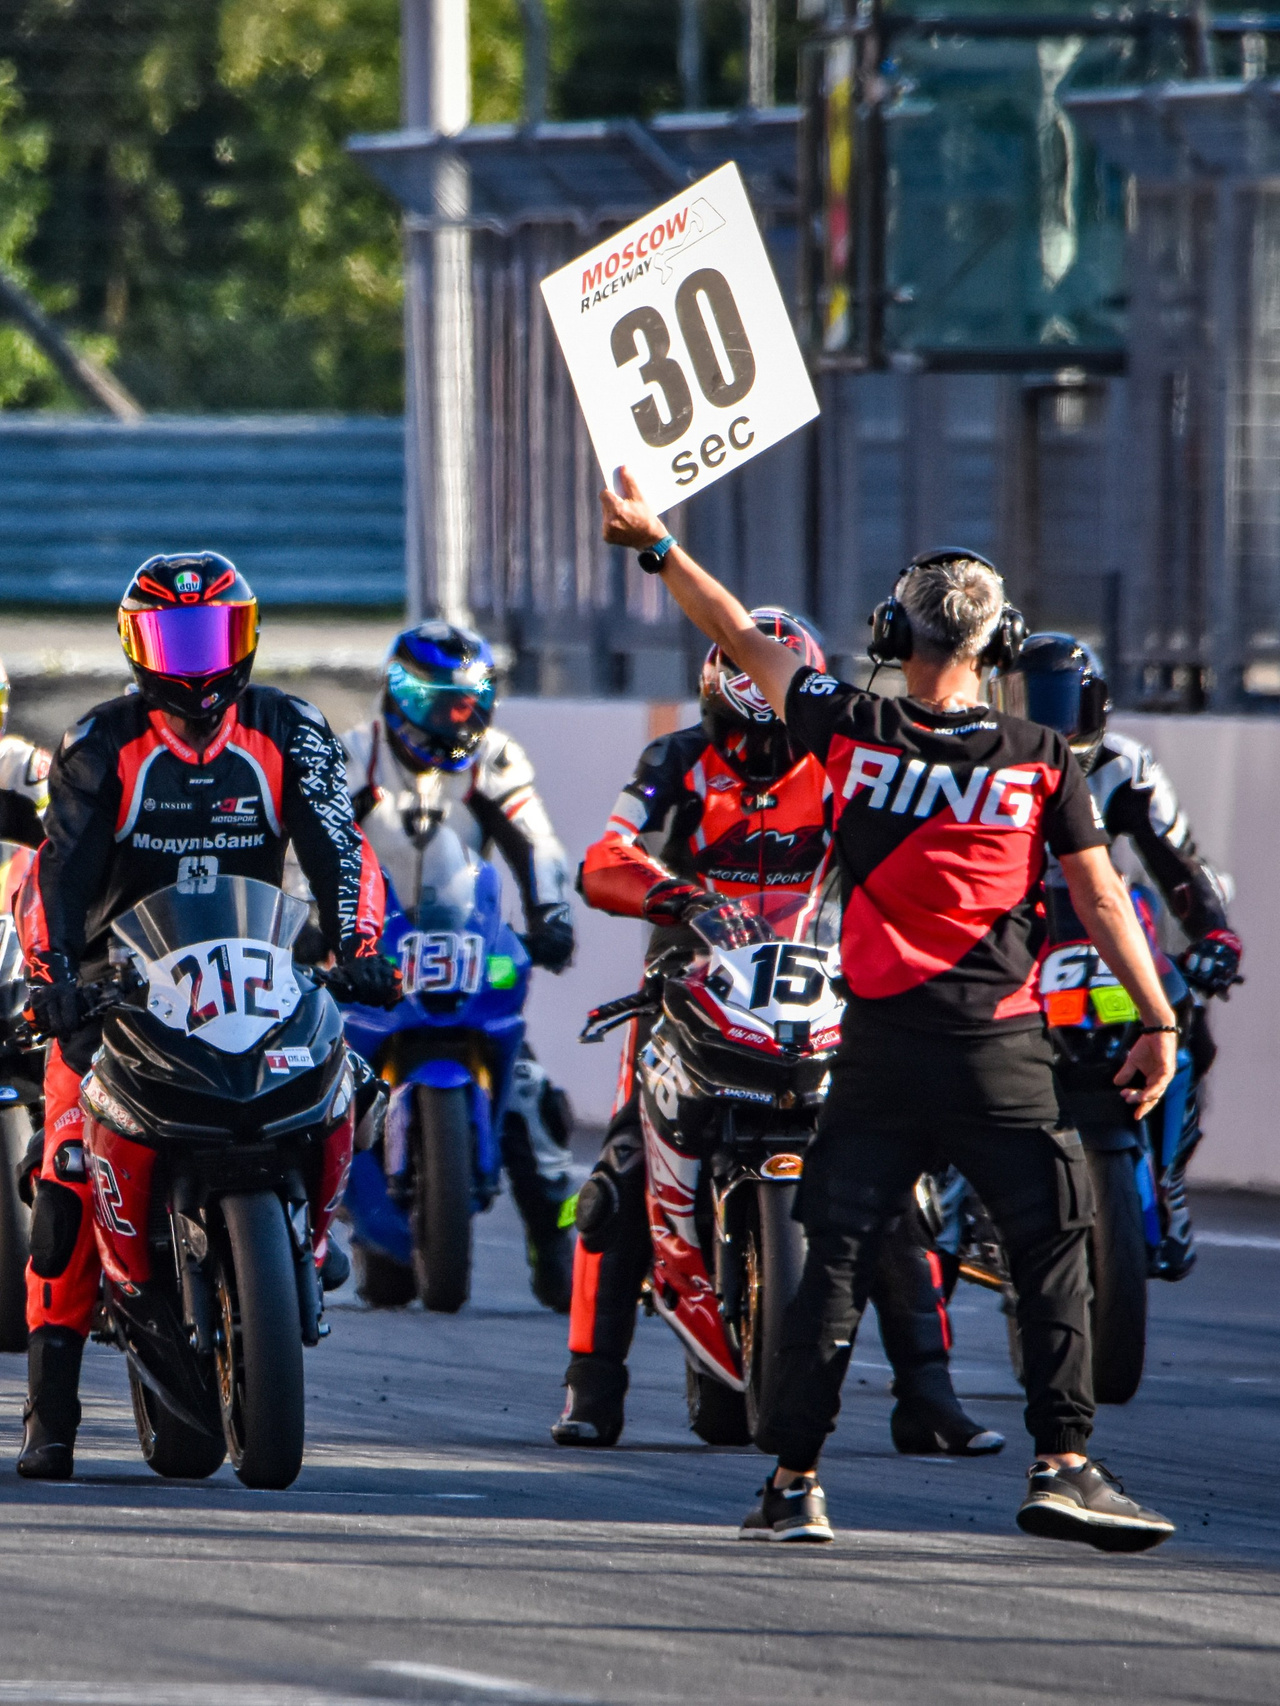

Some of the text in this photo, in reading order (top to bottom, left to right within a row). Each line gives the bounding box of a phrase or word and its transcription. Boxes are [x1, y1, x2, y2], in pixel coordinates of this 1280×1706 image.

[581, 207, 689, 294] MOSCOW
[580, 257, 652, 313] RACEWAY
[610, 268, 756, 447] 30
[671, 416, 755, 486] sec
[160, 802, 193, 810] INSIDE
[210, 815, 258, 823] MOTOSPORT
[842, 746, 1043, 827] RING
[133, 833, 265, 854] Модульбанк
[170, 944, 280, 1033] 212
[397, 931, 485, 994] 131
[749, 943, 829, 1011] 15
